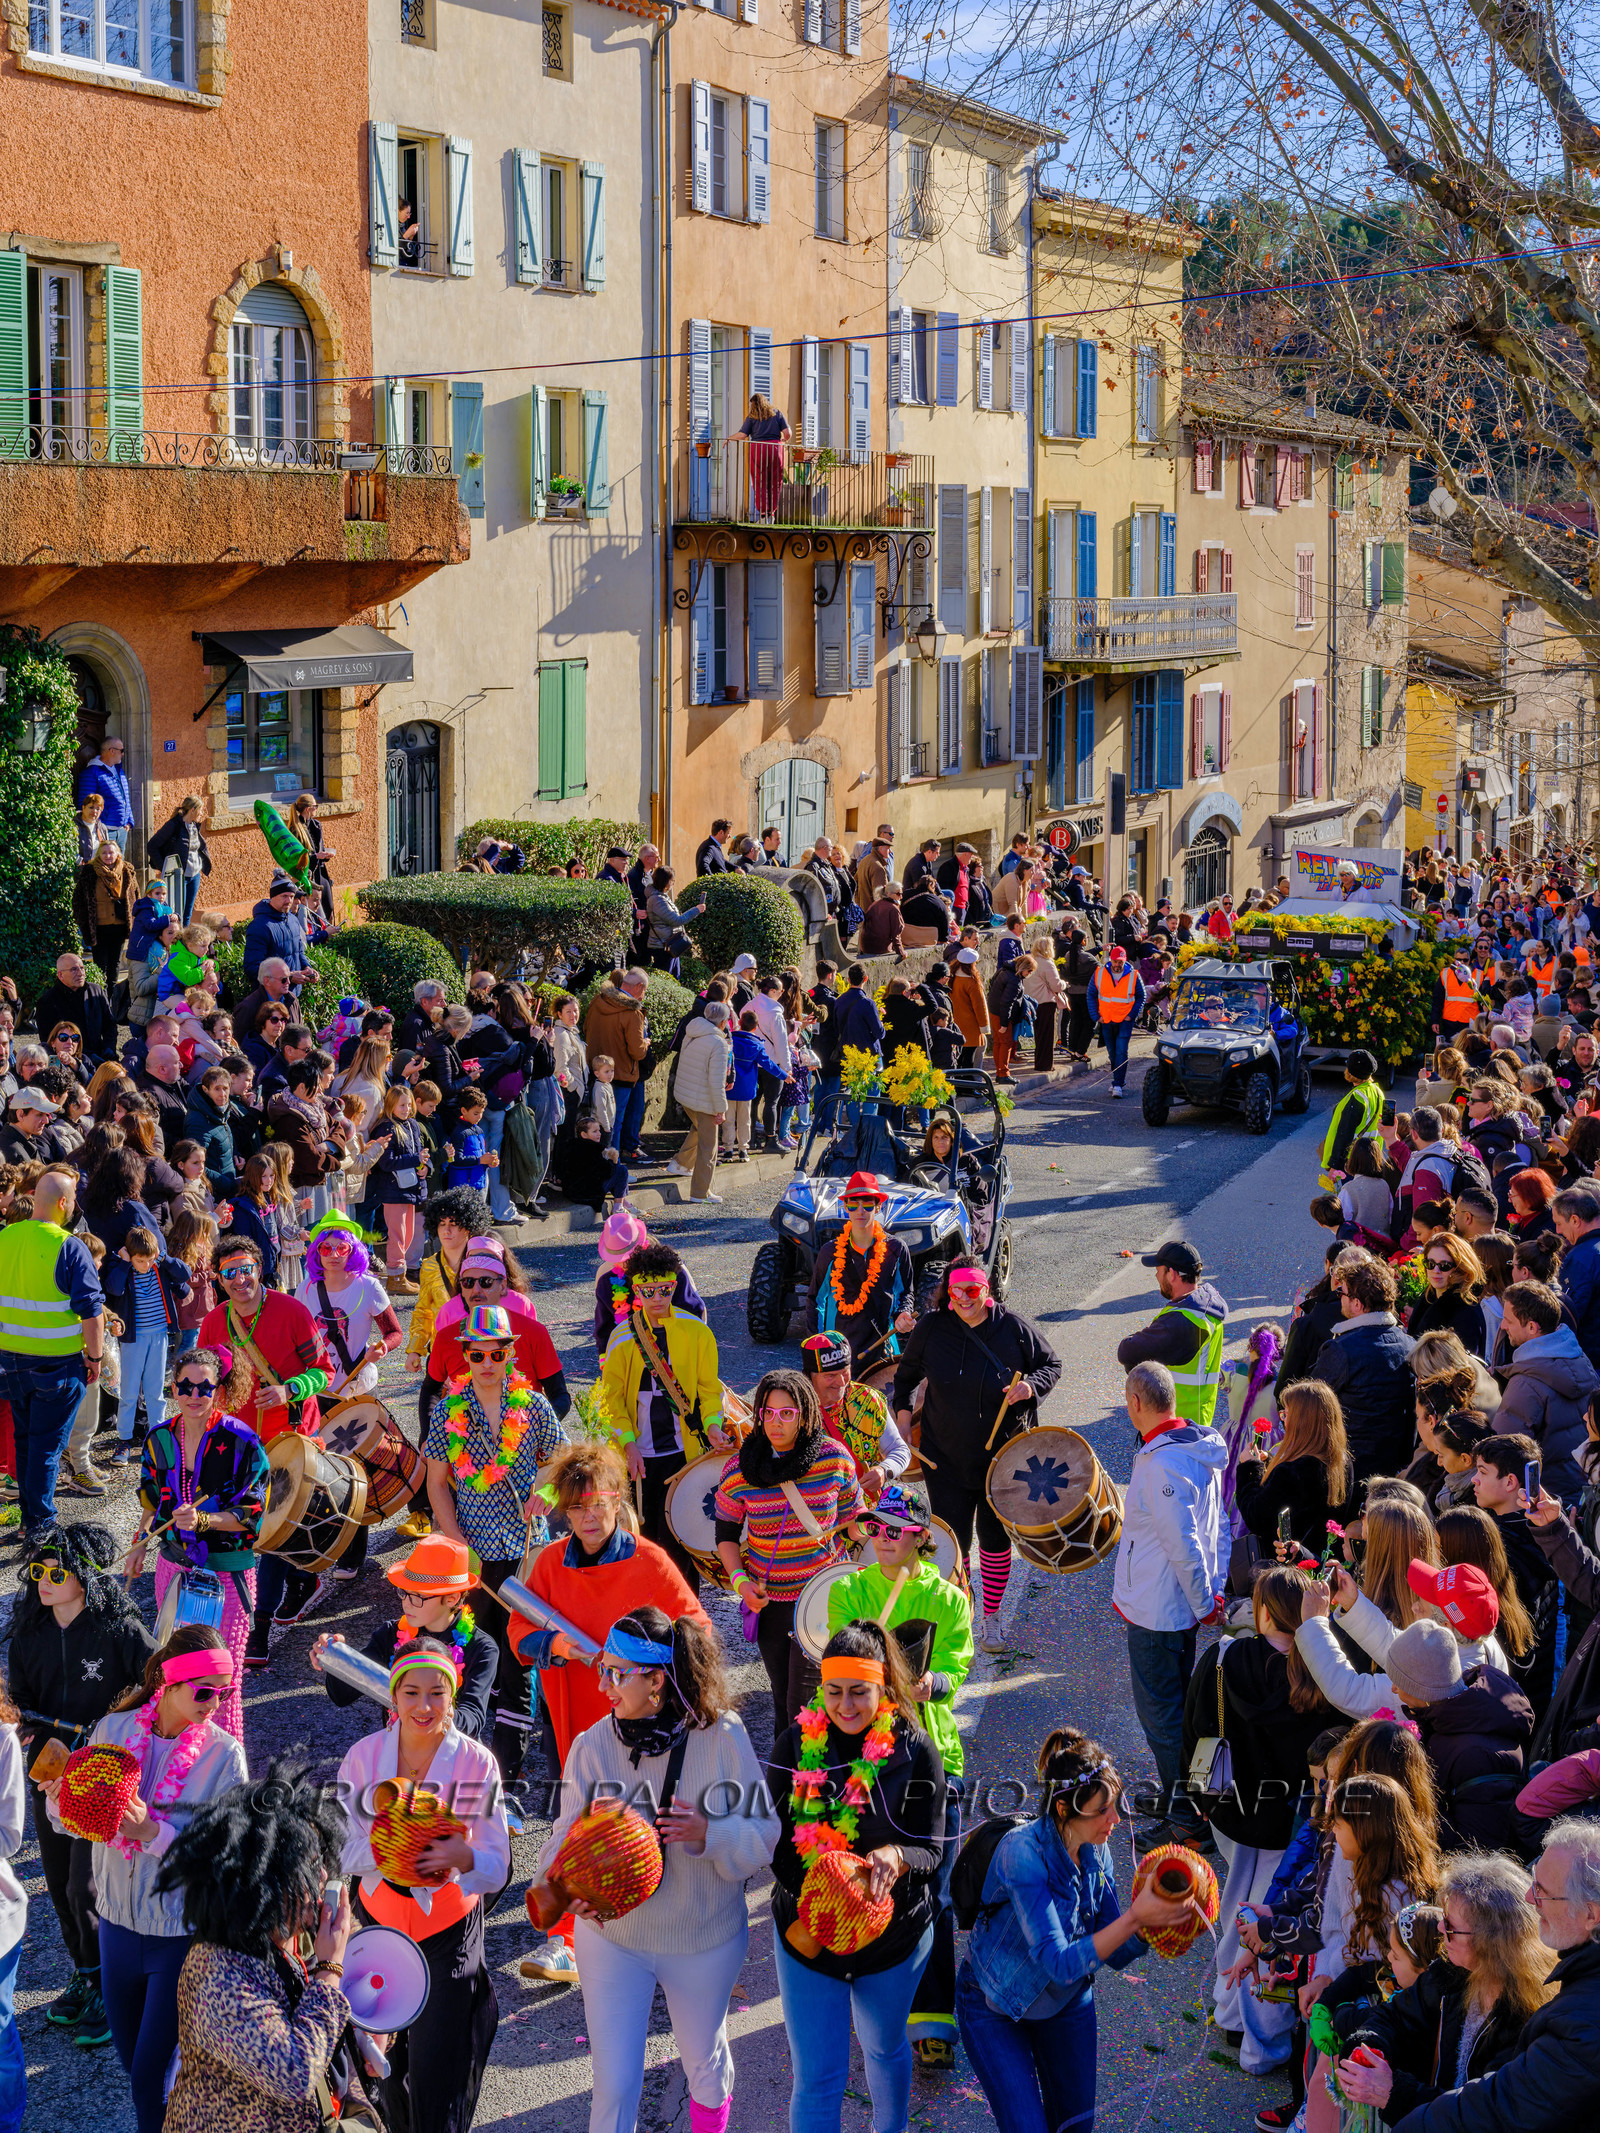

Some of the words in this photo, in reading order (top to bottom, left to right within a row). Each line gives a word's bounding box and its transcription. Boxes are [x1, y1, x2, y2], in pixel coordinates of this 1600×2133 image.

[310, 664, 342, 675] MAGREY
[345, 664, 351, 673] &
[352, 662, 373, 672] SONS
[1049, 820, 1073, 832] BARNES
[1055, 829, 1068, 848] B
[820, 1344, 849, 1364] OLODU
